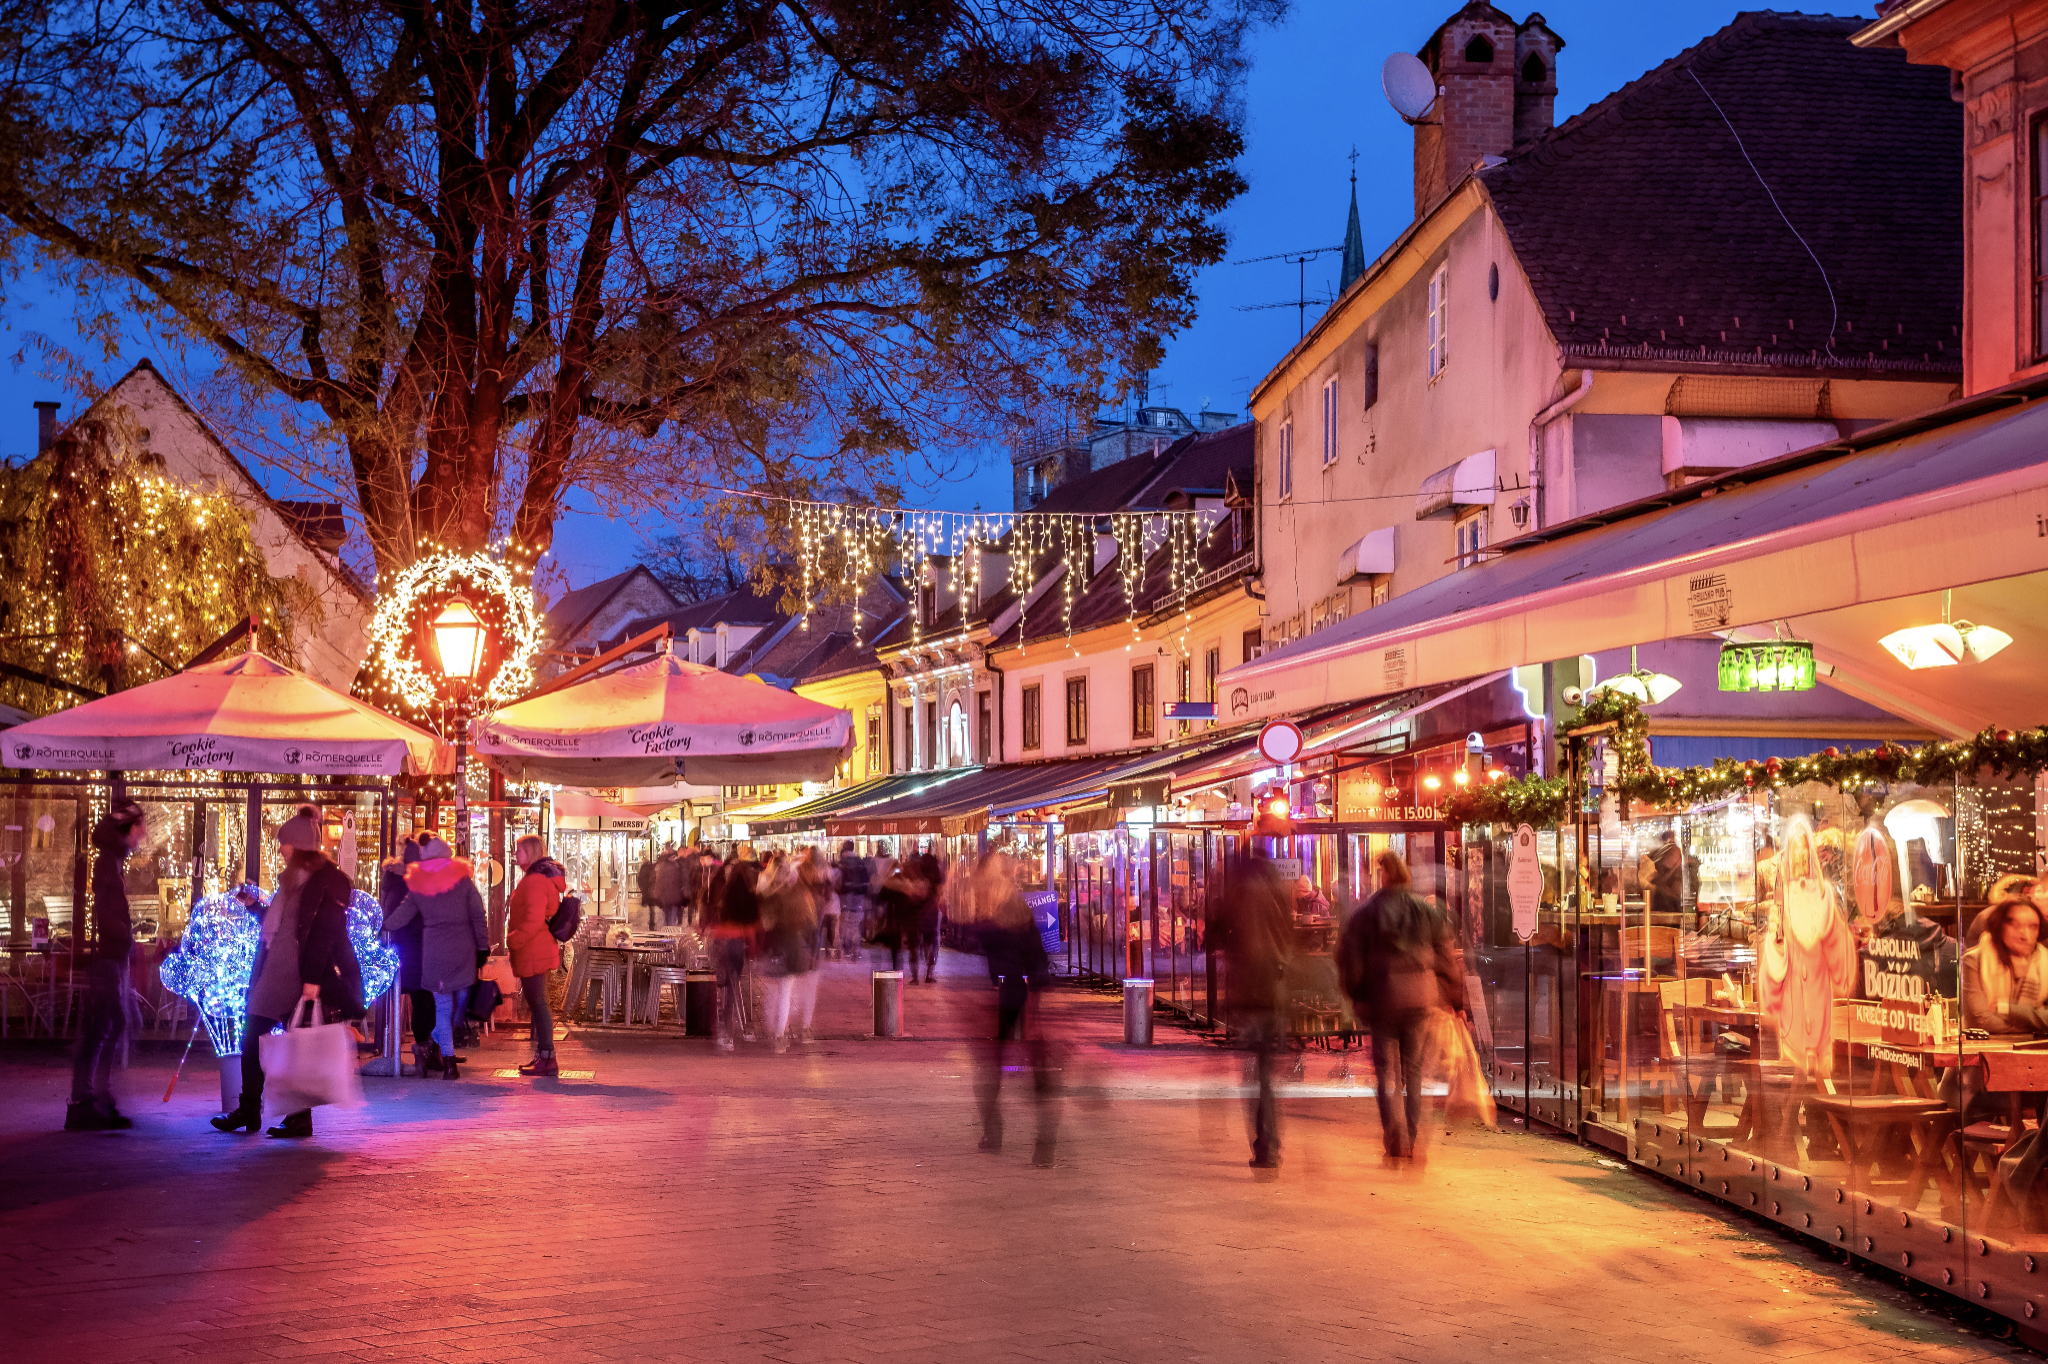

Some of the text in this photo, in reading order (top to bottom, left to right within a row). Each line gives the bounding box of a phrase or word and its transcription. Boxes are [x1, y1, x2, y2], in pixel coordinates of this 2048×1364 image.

[631, 725, 674, 744] Cookie
[171, 738, 216, 756] Cookie
[645, 736, 692, 754] Factory
[185, 751, 234, 767] Factory
[1889, 1009, 1906, 1030] OD
